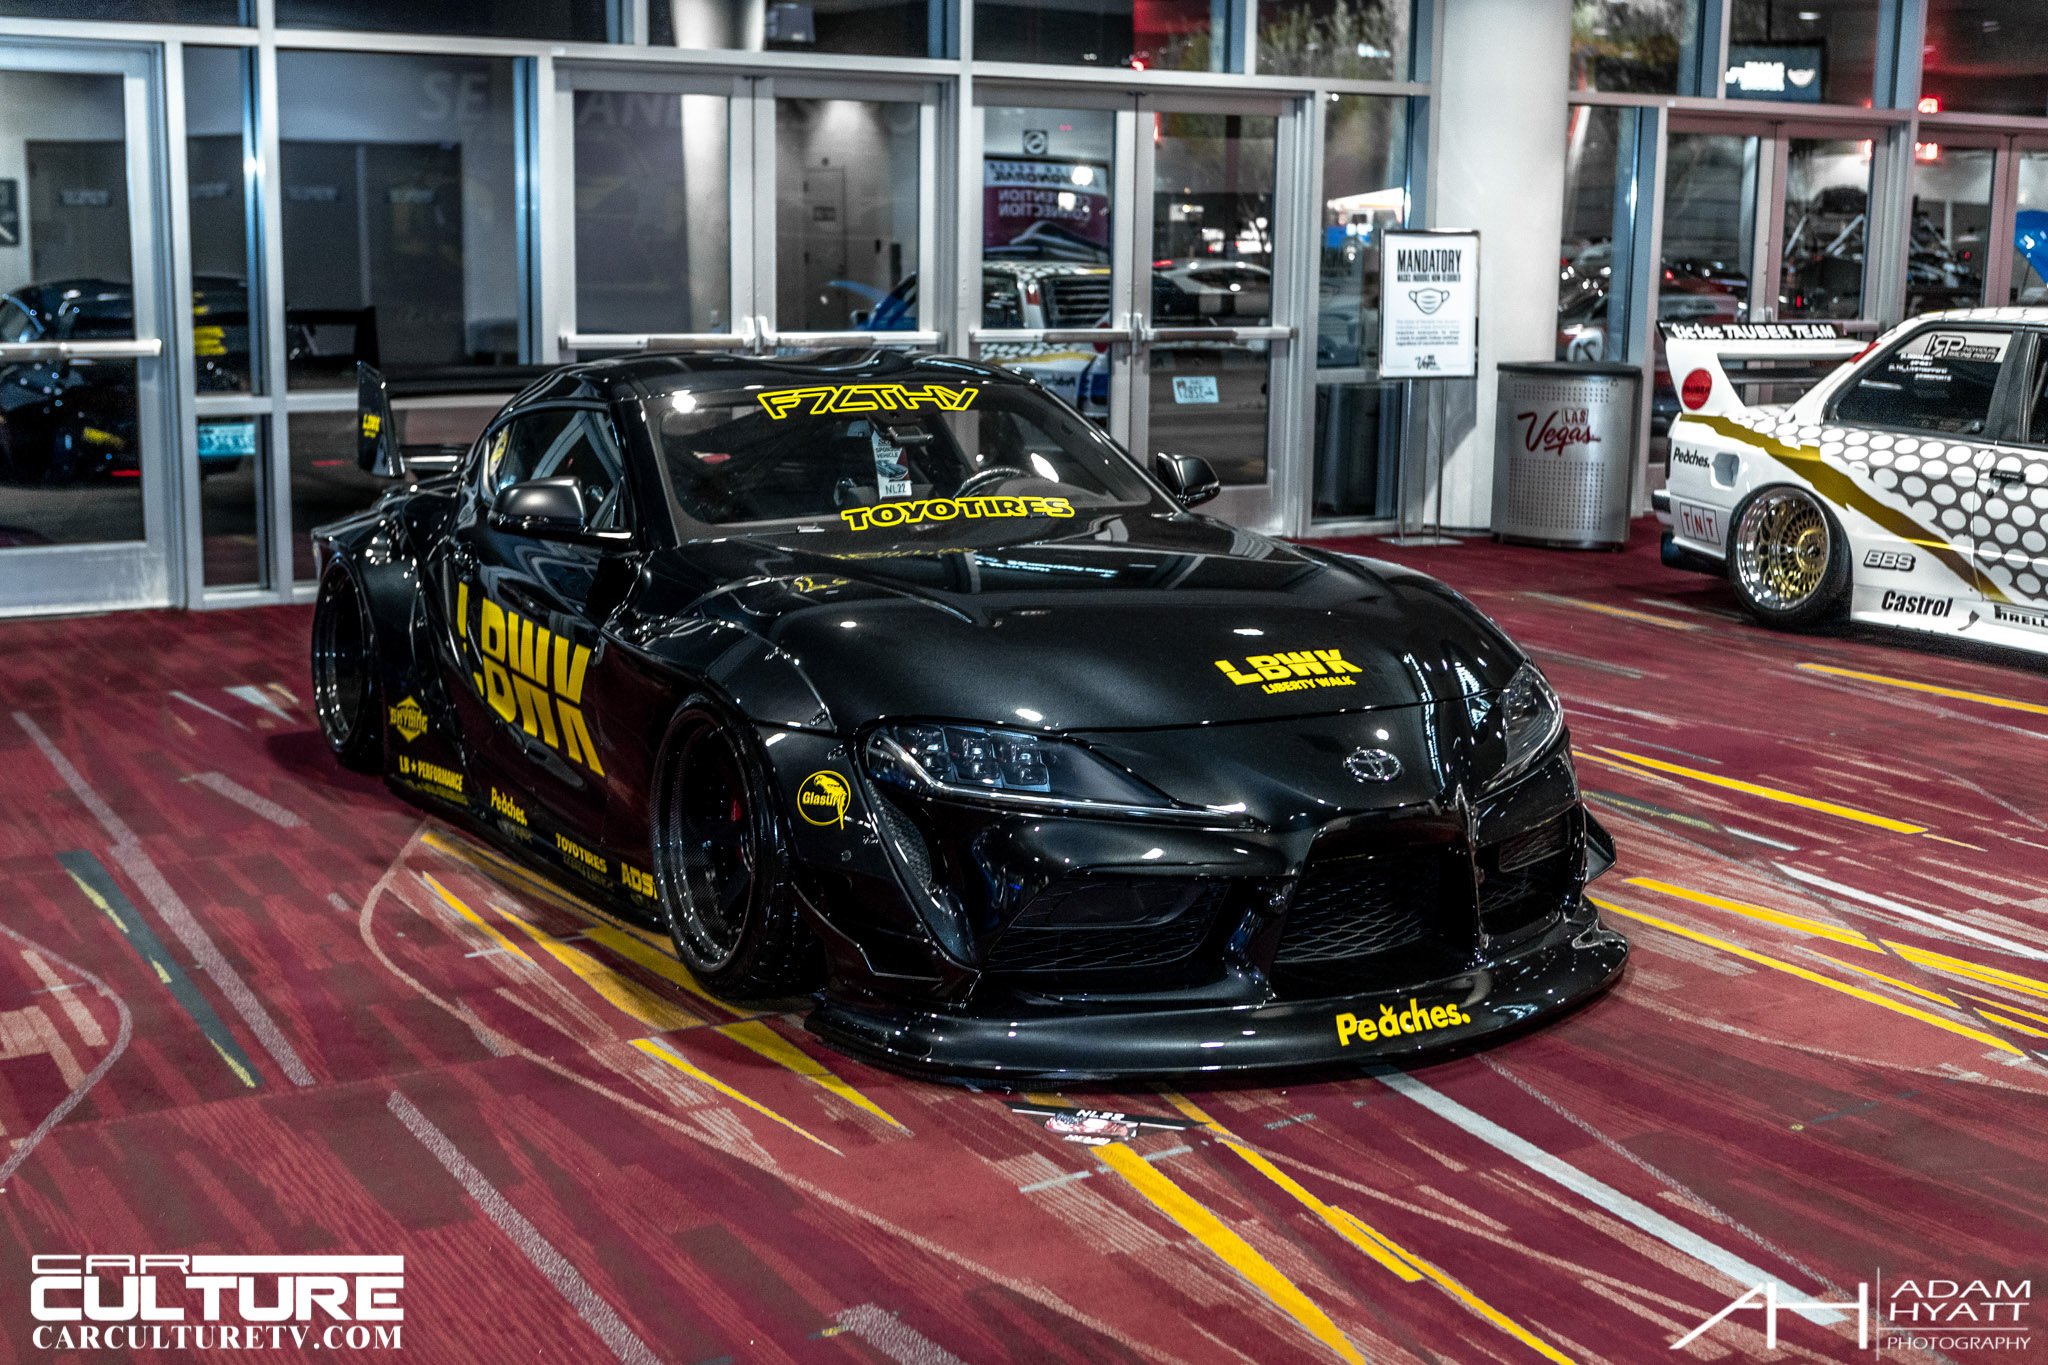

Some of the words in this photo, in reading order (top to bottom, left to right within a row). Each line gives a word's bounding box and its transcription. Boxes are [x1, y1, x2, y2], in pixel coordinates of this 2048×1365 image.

[1397, 249, 1462, 273] MANDATORY
[1722, 324, 1794, 340] TAUBER
[1790, 325, 1837, 340] TEAM
[1564, 409, 1587, 424] LAS
[1517, 410, 1601, 456] Vegas
[885, 484, 906, 494] NL22
[1863, 550, 1916, 572] BBS
[1881, 589, 1953, 618] Castrol
[1214, 649, 1363, 685] LBWK
[1261, 678, 1317, 695] LIBERTY
[1315, 675, 1357, 688] WALK
[399, 754, 411, 774] LB
[417, 760, 464, 792] PERFORMANCE
[1335, 997, 1471, 1047] Peaches.
